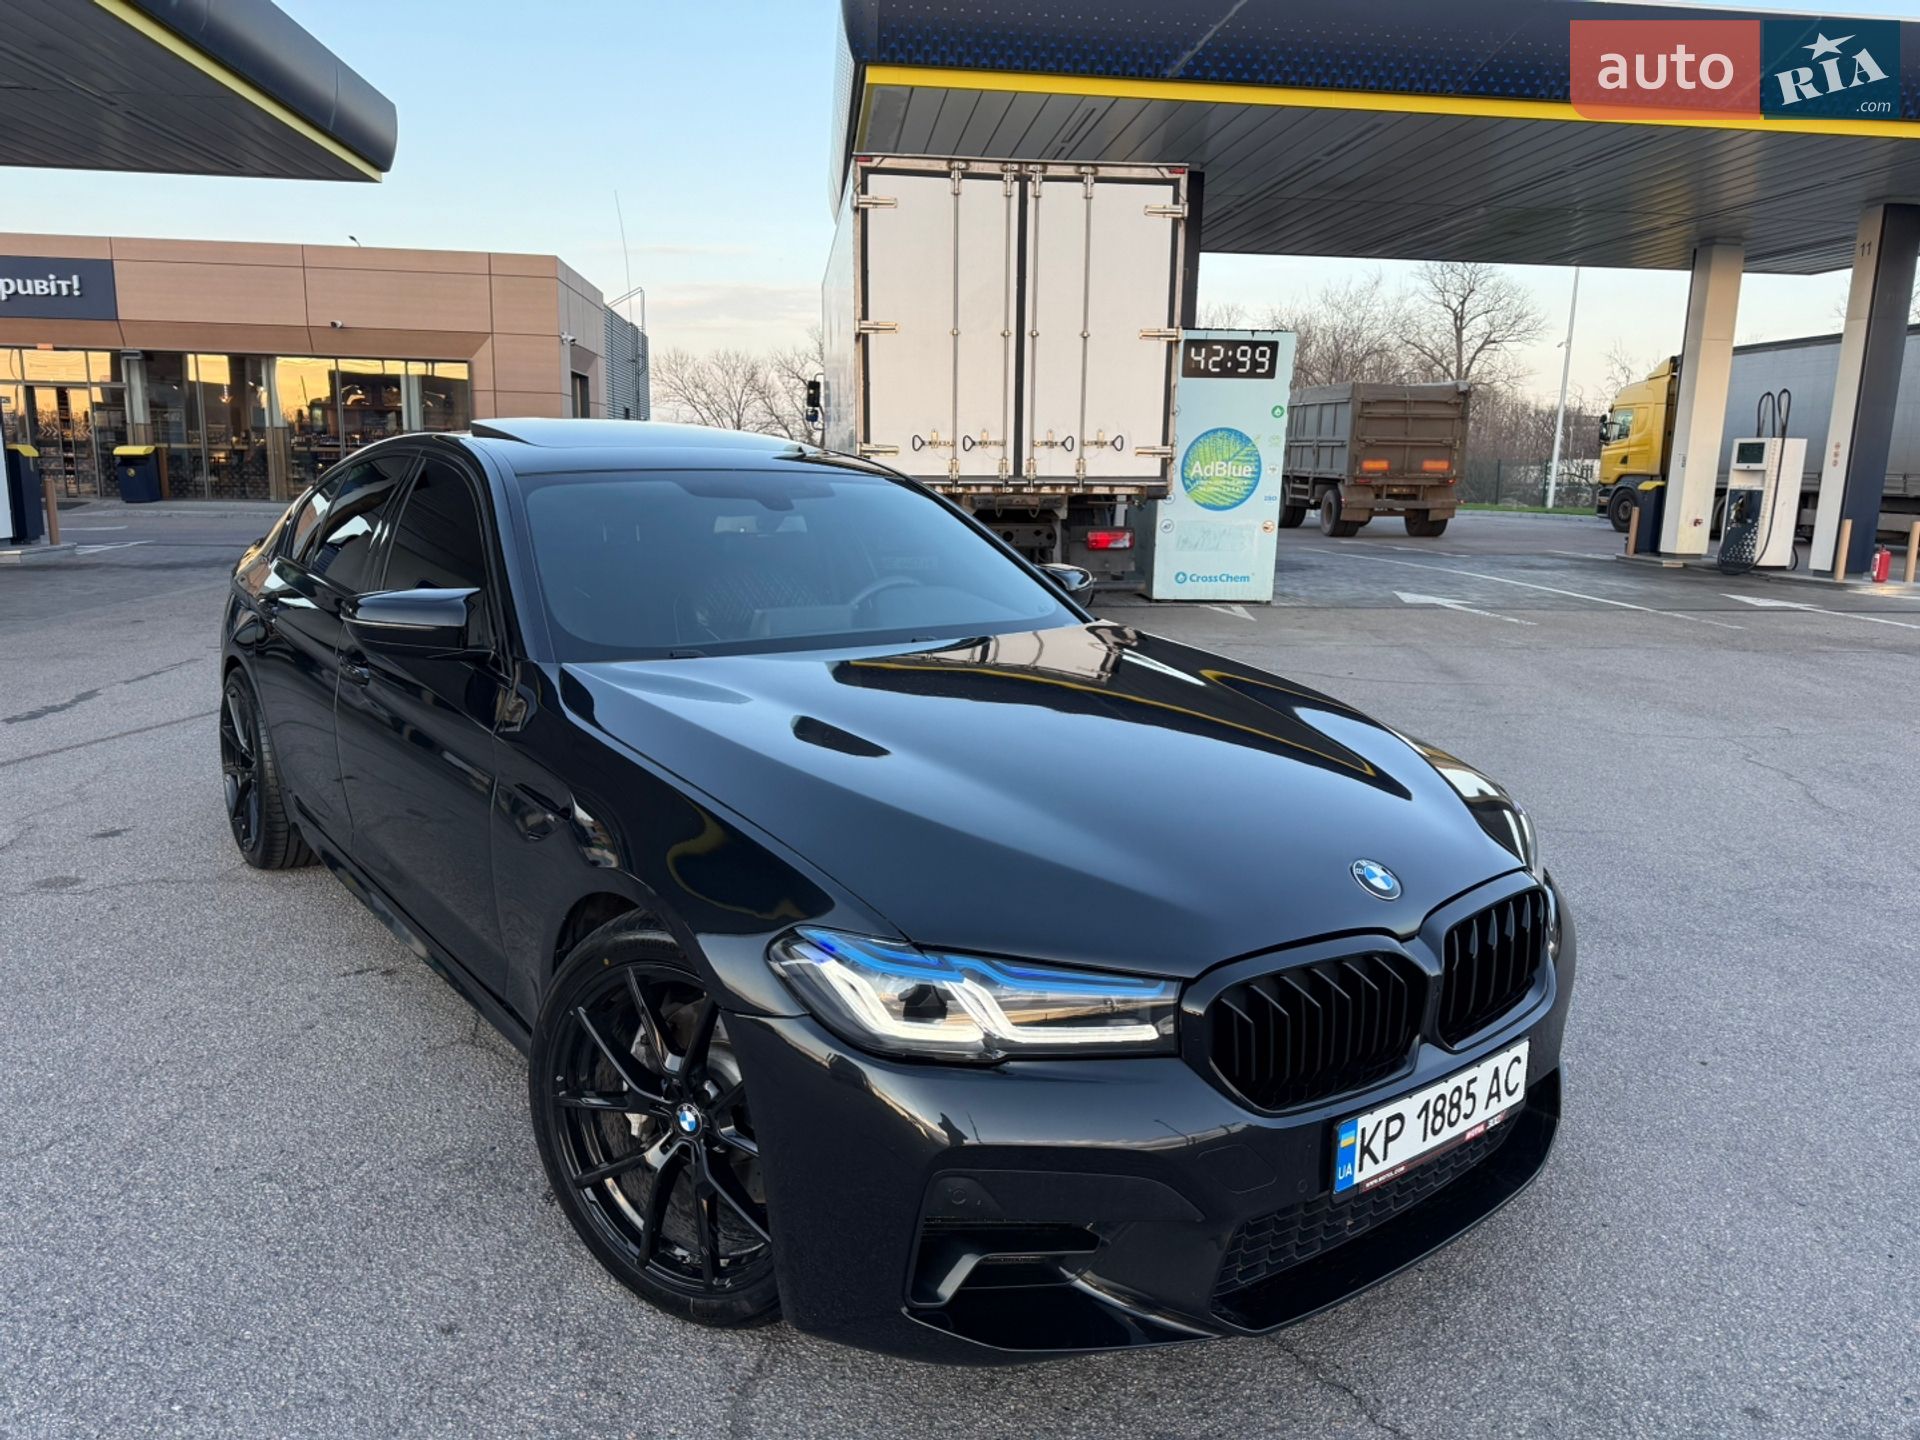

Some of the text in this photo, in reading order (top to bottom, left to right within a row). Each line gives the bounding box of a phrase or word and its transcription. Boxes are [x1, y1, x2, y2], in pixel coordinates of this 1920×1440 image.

[1860, 241, 1872, 257] 11
[1191, 460, 1253, 477] AdBlue
[1189, 572, 1250, 584] CrossChem
[1358, 1112, 1406, 1173] KP
[1417, 1076, 1478, 1142] 1885
[1485, 1055, 1522, 1110] AC
[1338, 1163, 1353, 1180] UA
